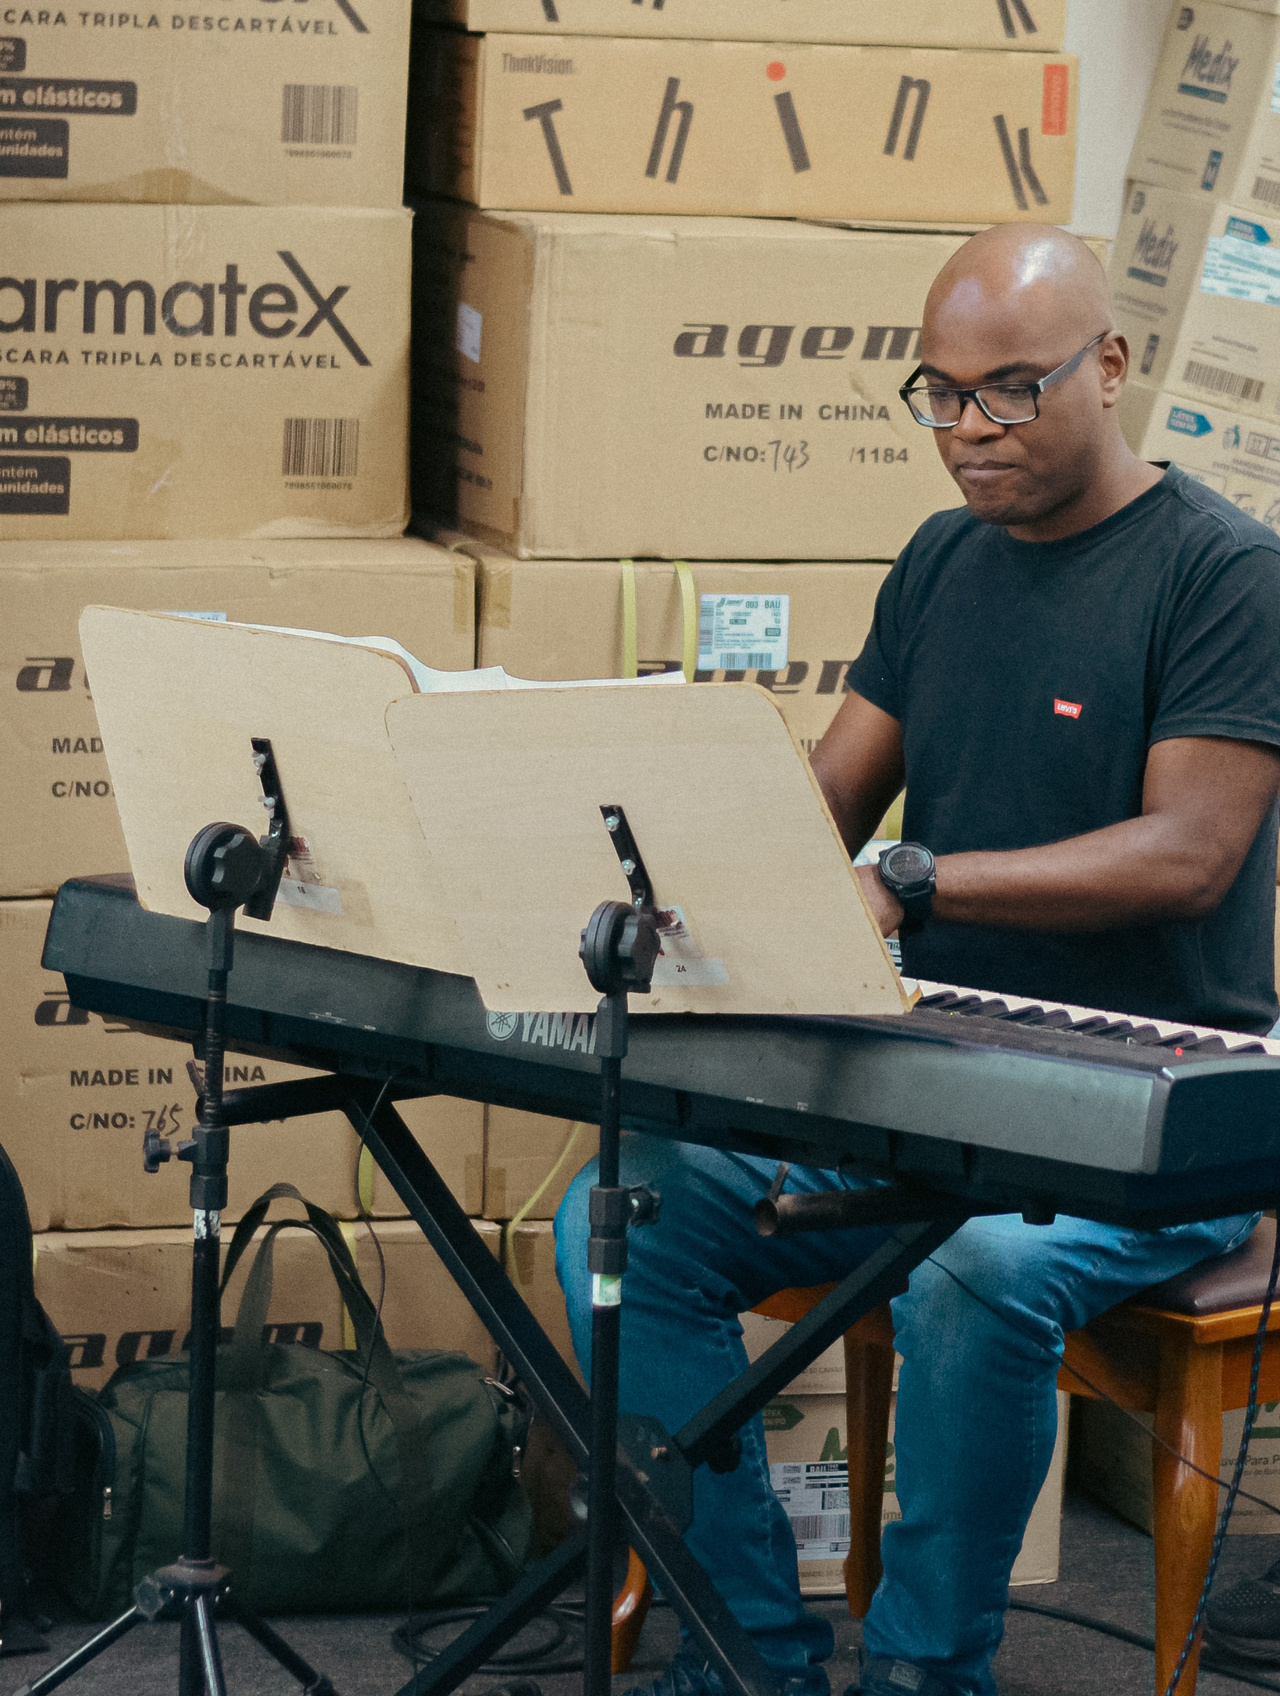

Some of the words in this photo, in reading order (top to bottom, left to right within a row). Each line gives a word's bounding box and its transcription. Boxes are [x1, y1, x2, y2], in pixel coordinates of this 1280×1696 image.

[78, 11, 161, 29] TRIPLA
[171, 16, 339, 35] DESCARTÁVEL
[0, 349, 69, 365] CARA
[81, 351, 163, 368] TRIPLA
[174, 351, 341, 369] DESCARTÁVEL
[705, 403, 771, 420] MADE
[780, 404, 803, 420] IN
[818, 403, 891, 421] CHINA
[24, 424, 124, 445] elásticos
[703, 445, 767, 463] C/NO:
[849, 446, 909, 464] /1184
[764, 600, 781, 609] BAU
[70, 1069, 139, 1087] MADE
[149, 1068, 173, 1085] IN
[69, 1112, 136, 1130] C/NO:
